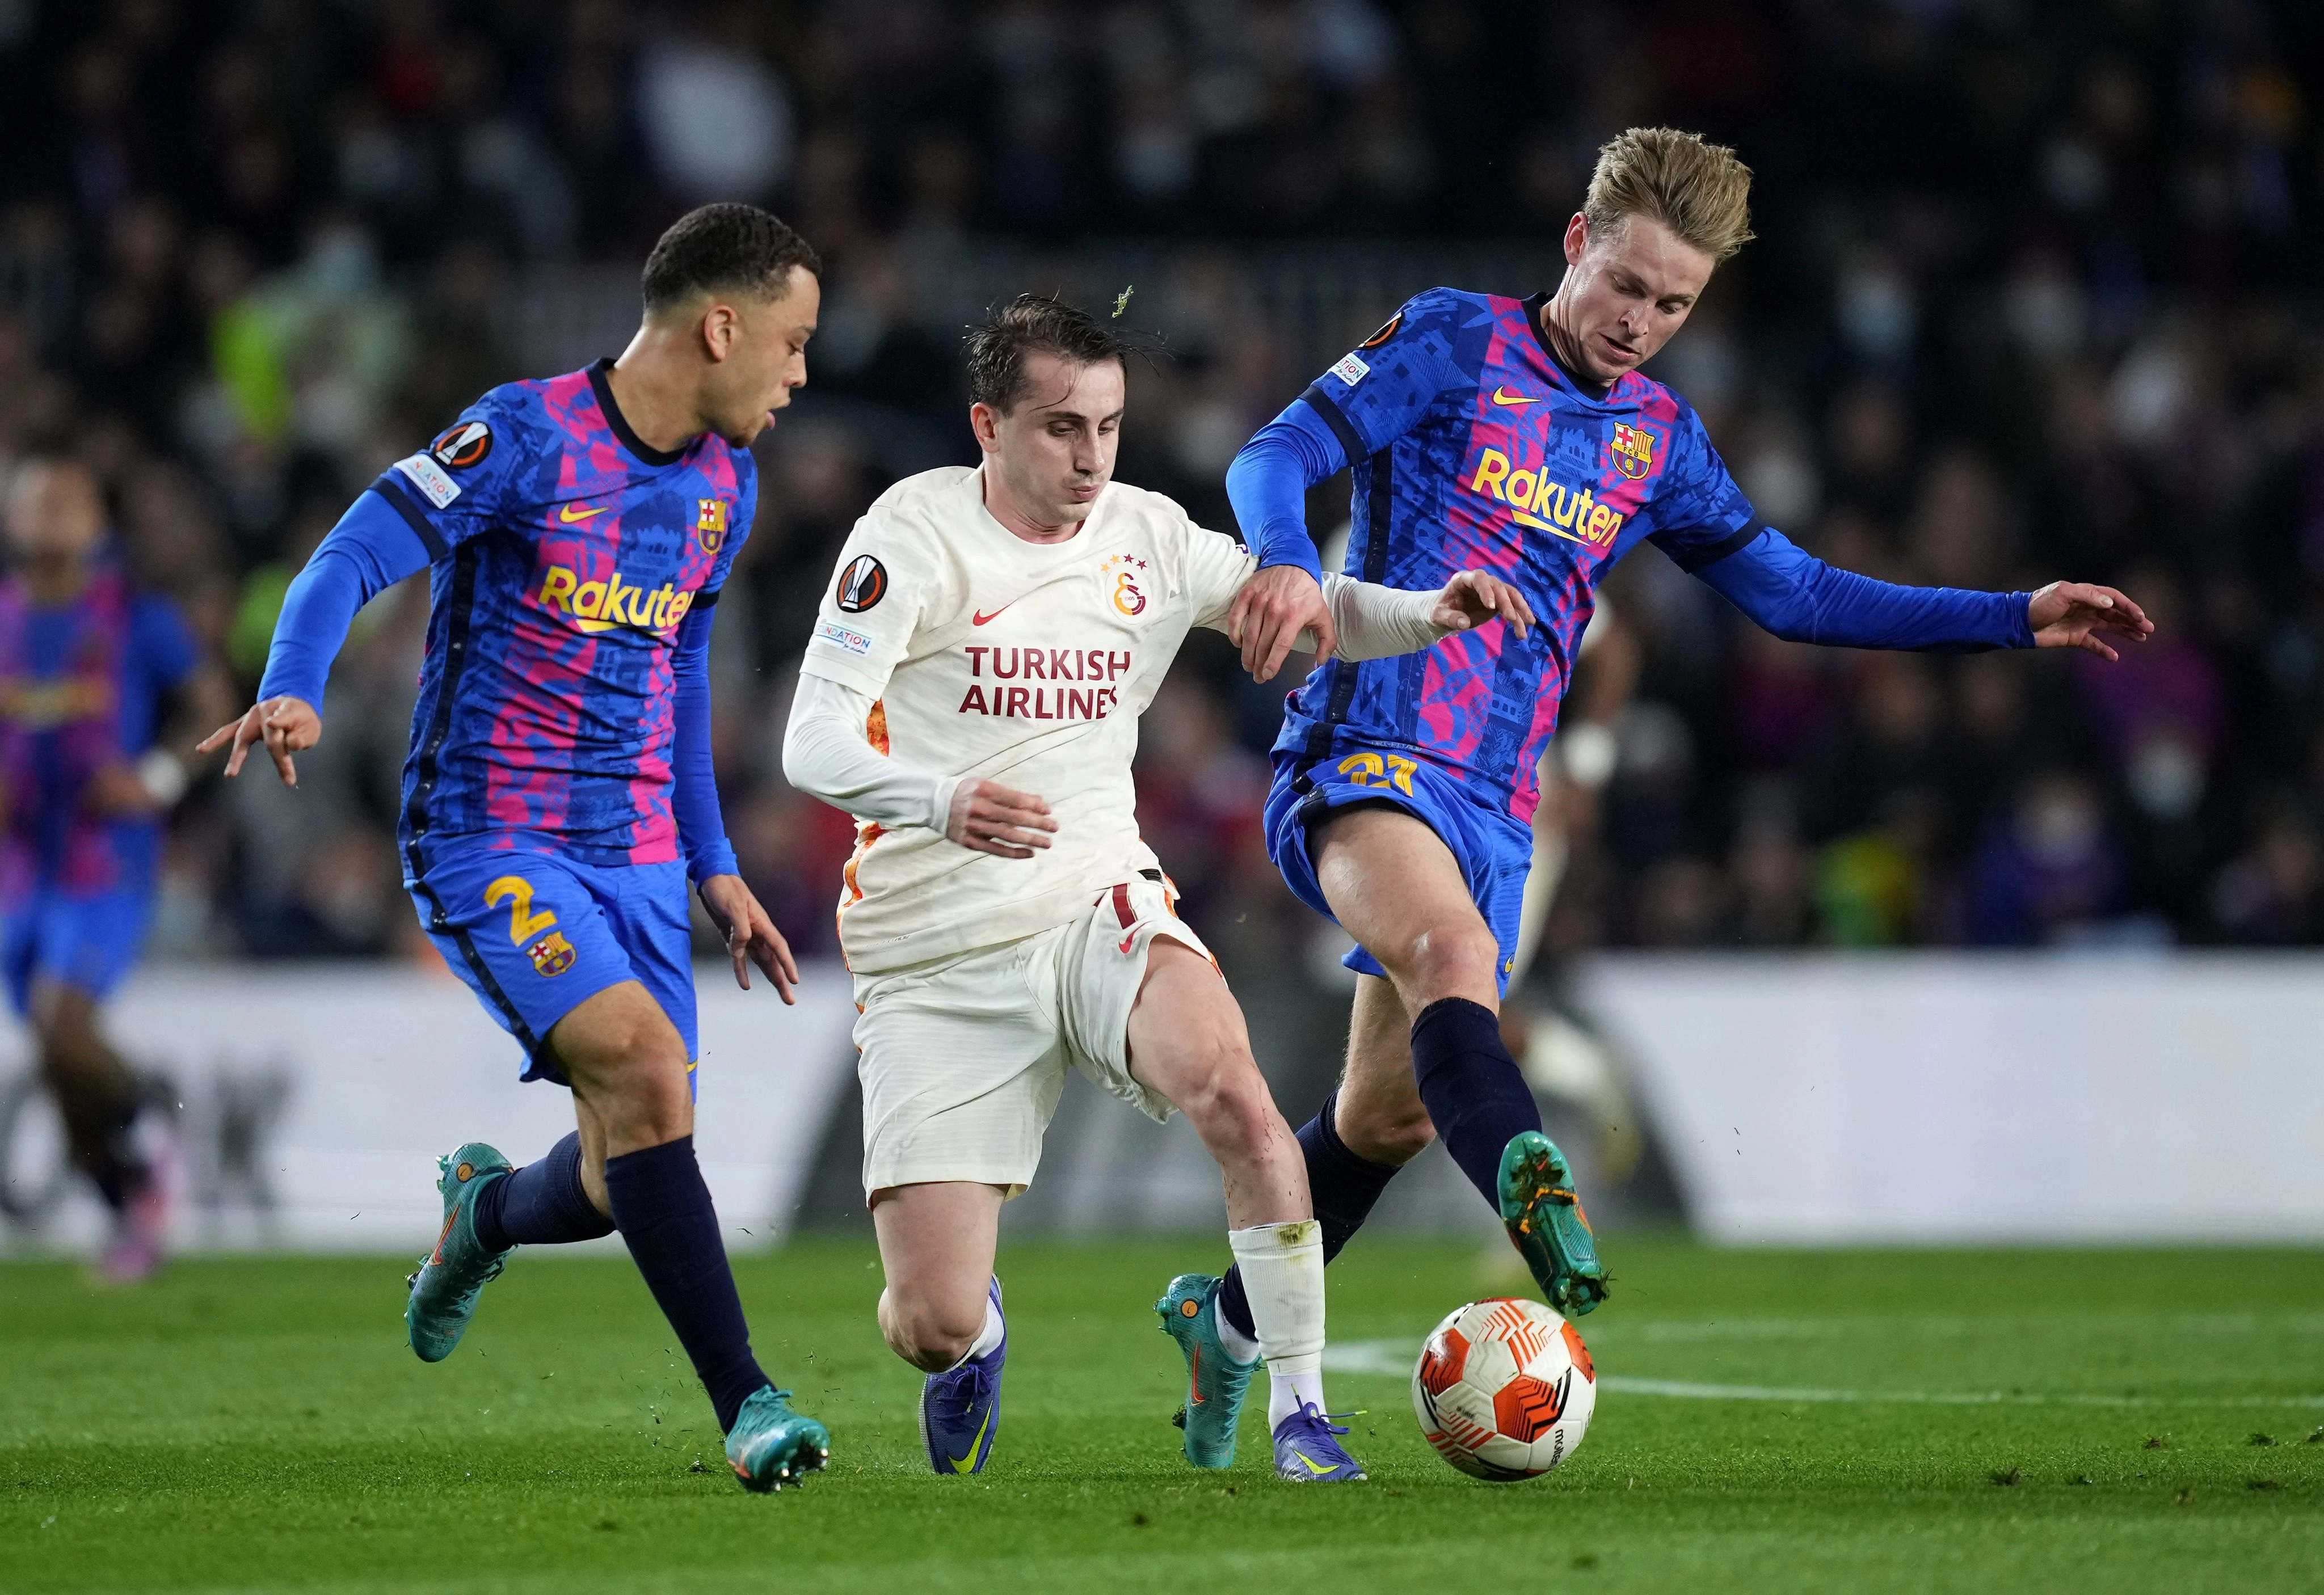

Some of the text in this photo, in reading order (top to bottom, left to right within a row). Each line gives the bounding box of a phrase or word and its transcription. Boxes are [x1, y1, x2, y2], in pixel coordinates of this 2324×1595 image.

[1623, 446, 1639, 458] FCB
[1471, 448, 1623, 547] Rakuten
[965, 647, 1130, 681] TURKISH
[958, 685, 1117, 719] AIRLINES
[1337, 752, 1417, 798] 21
[484, 875, 557, 947] 2
